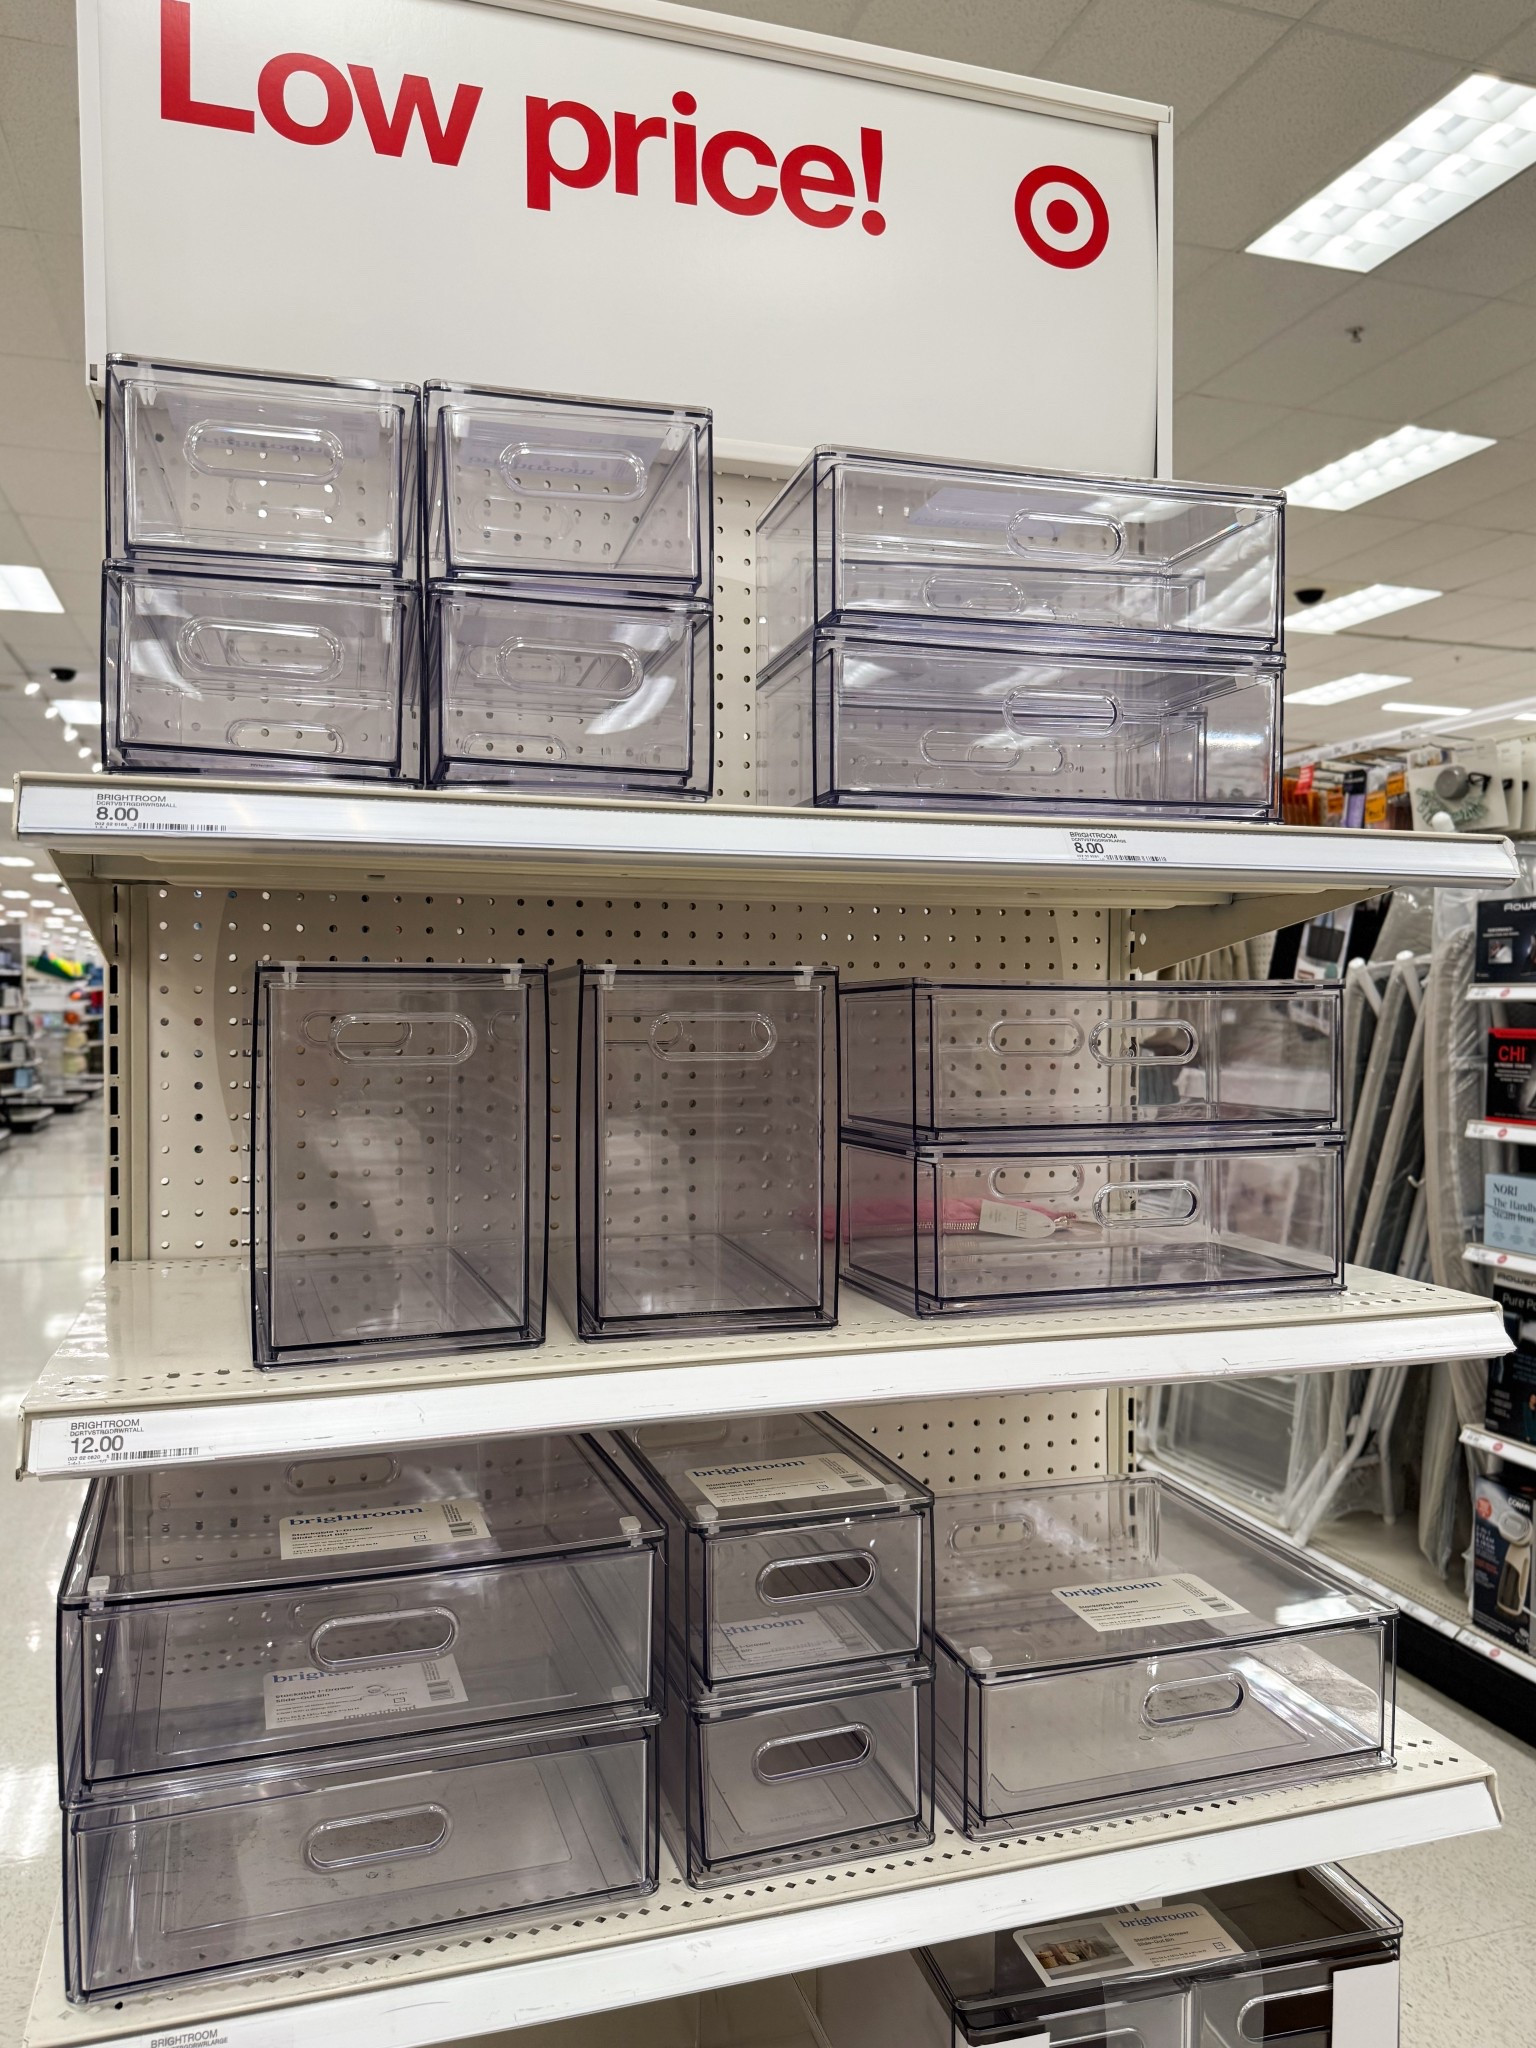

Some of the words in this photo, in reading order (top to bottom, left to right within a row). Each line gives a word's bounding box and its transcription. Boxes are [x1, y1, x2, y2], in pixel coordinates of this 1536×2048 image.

[160, 0, 483, 167] Low
[526, 91, 886, 236] price!
[97, 793, 167, 803] BRIGHTROOM
[96, 806, 139, 821] 8.00
[1069, 831, 1118, 839] BRIGHTROOM
[1074, 842, 1104, 854] 8.00
[1498, 1045, 1526, 1062] CHI
[1493, 1183, 1518, 1197] NORI
[1493, 1197, 1507, 1208] The
[1502, 1292, 1525, 1309] Pure
[70, 1418, 140, 1431] BRIGHTROOM
[70, 1435, 124, 1454] 12.00
[692, 1461, 806, 1477] brightroom
[290, 1507, 423, 1526] brightroom
[1059, 1581, 1163, 1598] brightroom
[1119, 1910, 1200, 1928] brightroom
[151, 2028, 218, 2048] BRIGHTROOM
